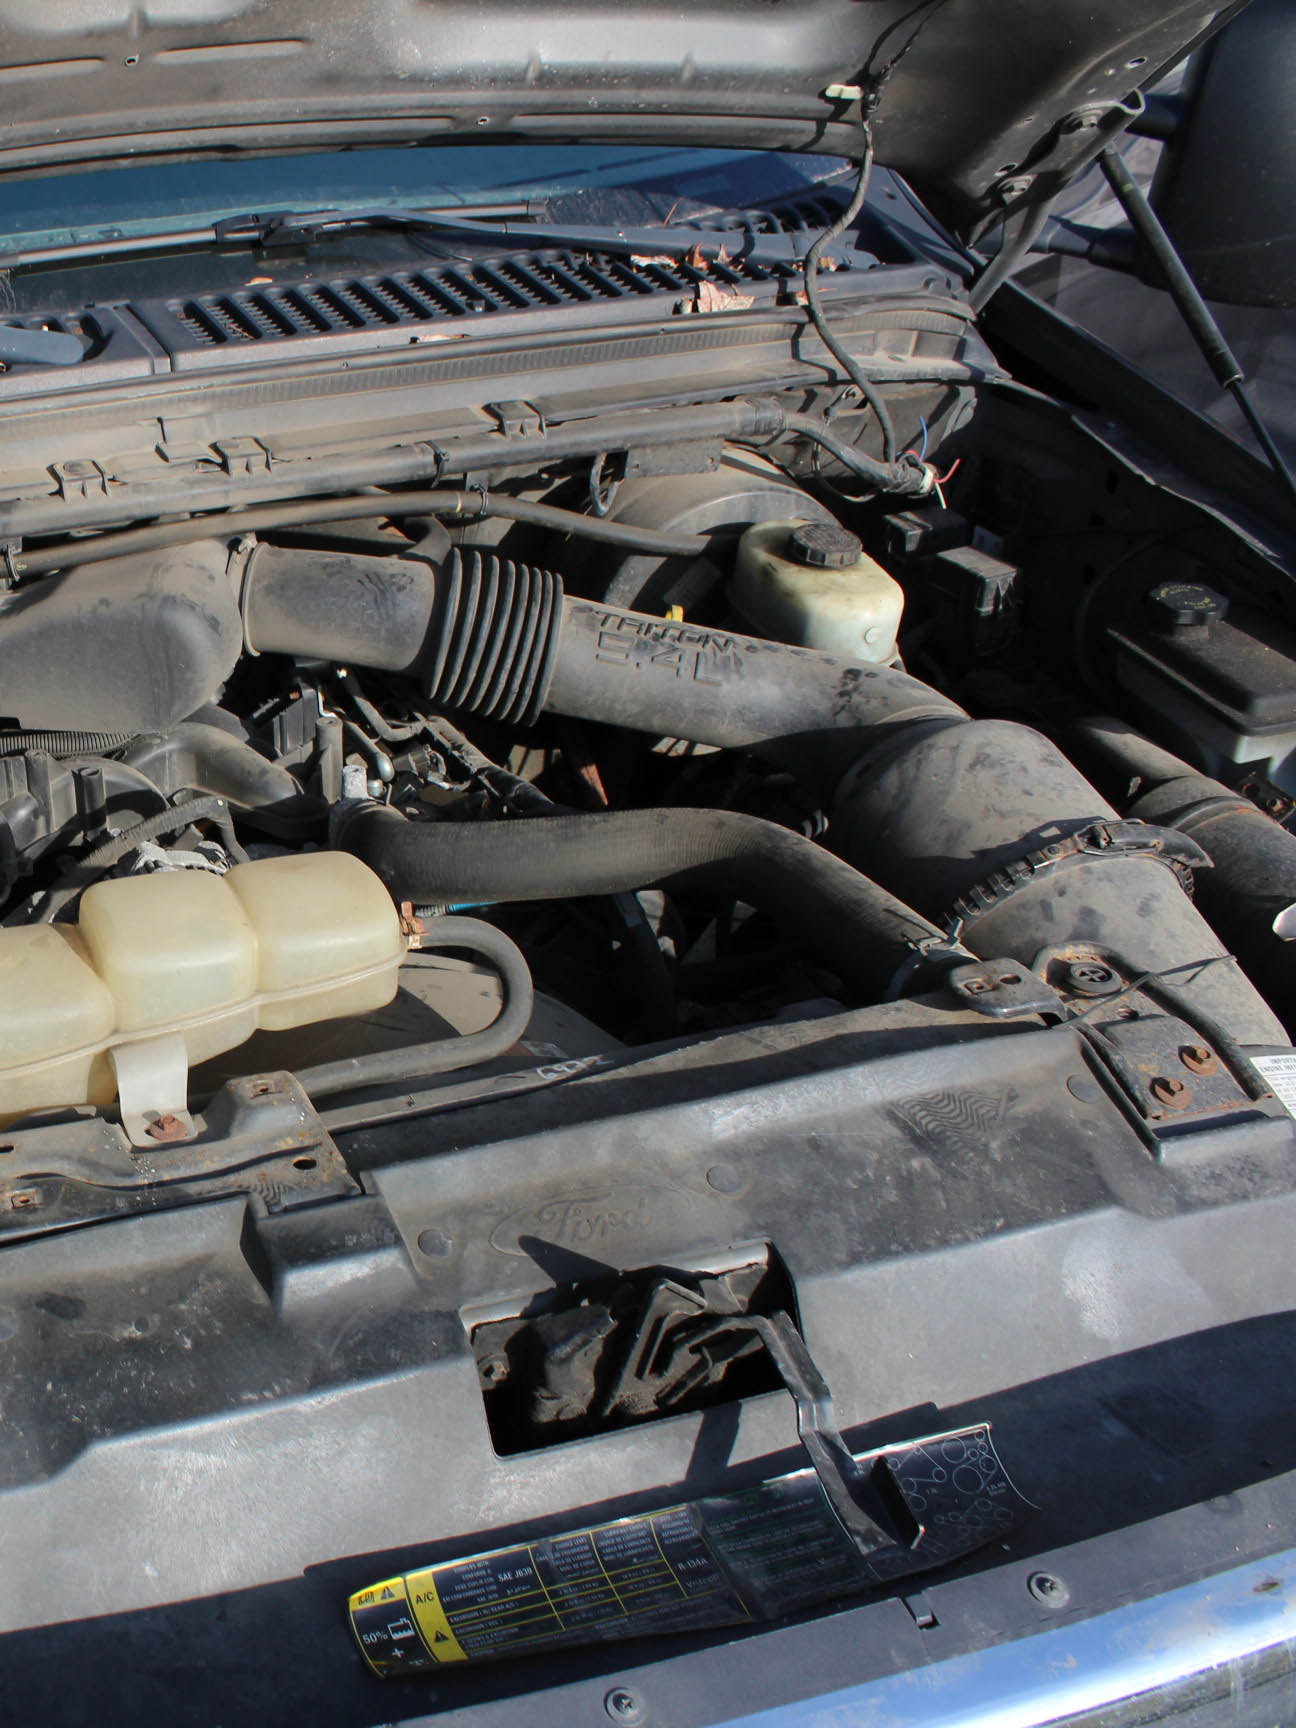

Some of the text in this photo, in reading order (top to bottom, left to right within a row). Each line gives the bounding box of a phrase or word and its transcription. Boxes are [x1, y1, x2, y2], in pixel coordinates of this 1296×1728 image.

[594, 631, 723, 687] 5.4L
[497, 1572, 512, 1584] SAE
[415, 1590, 435, 1606] A/C
[362, 1629, 389, 1646] 50%
